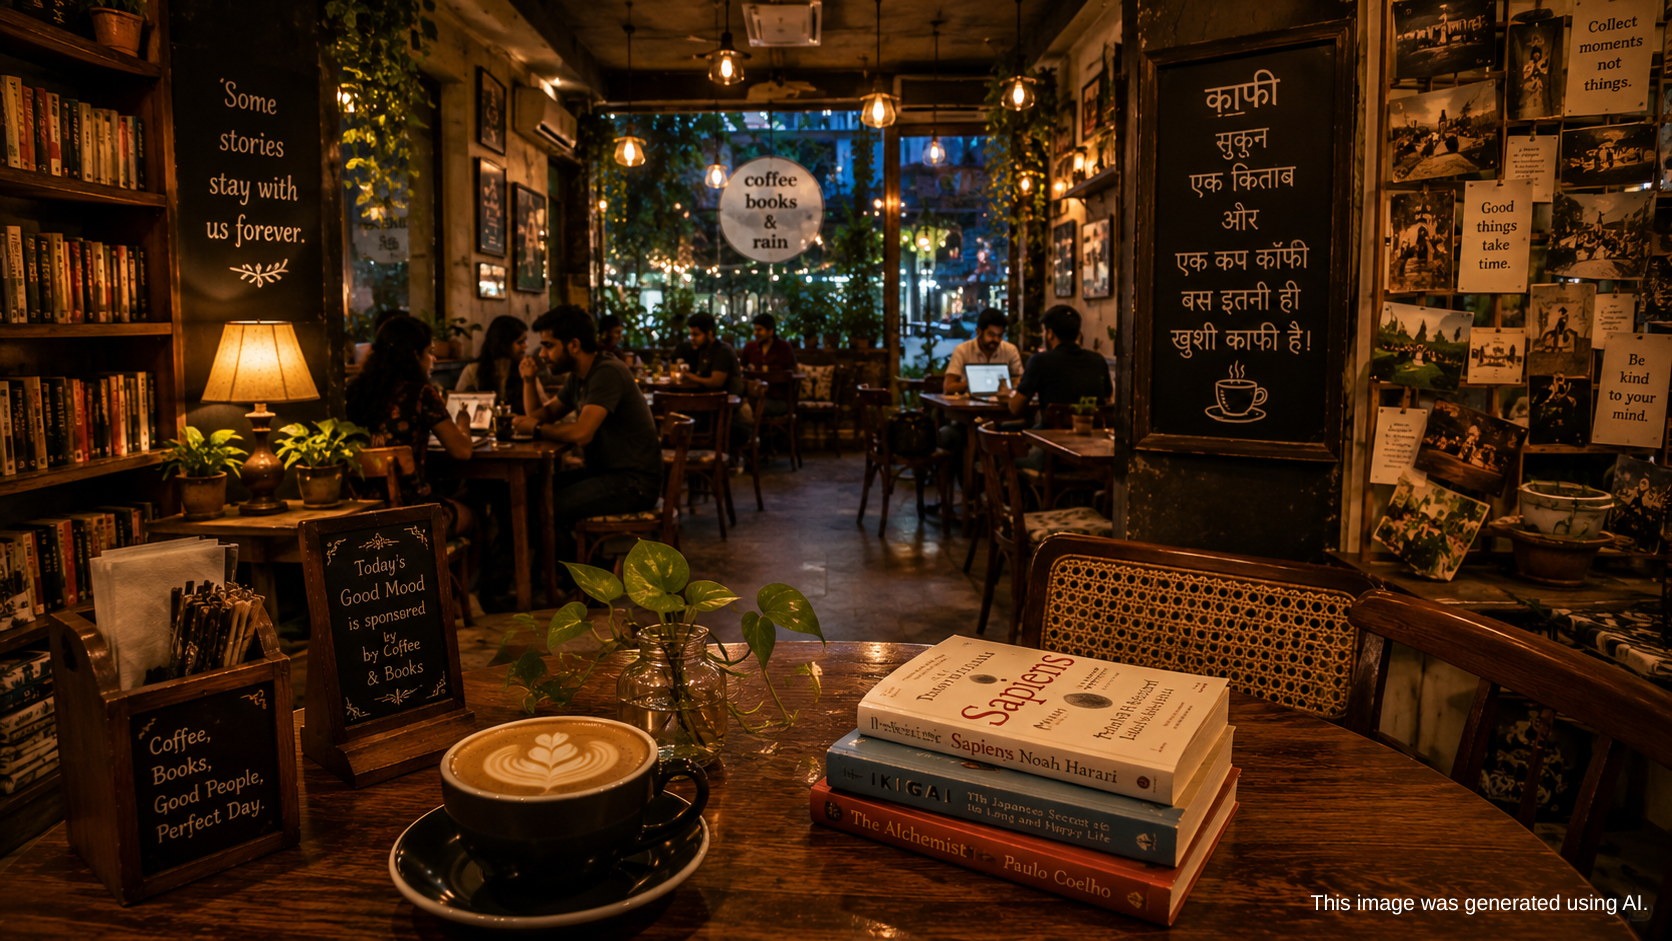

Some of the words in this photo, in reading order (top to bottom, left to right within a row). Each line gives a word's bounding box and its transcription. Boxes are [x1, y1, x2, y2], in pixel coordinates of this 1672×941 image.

[1588, 16, 1638, 33] Collect
[1579, 36, 1643, 54] moments
[1597, 57, 1622, 71] not
[1584, 76, 1632, 93] things.
[219, 130, 284, 158] stories
[1215, 127, 1270, 160] सुकून
[209, 172, 250, 206] stay
[257, 174, 298, 201] with
[744, 171, 798, 187] coffee
[1189, 172, 1224, 198] एक
[1231, 162, 1296, 192] किताब
[745, 193, 798, 209] books
[1481, 200, 1514, 214] Good
[764, 214, 776, 229] &
[1221, 202, 1260, 231] और
[1477, 219, 1517, 235] things
[206, 221, 229, 240] us
[235, 213, 306, 248] forever.
[753, 234, 788, 249] rain
[1174, 252, 1208, 277] एक
[1214, 250, 1249, 271] कप
[1256, 239, 1310, 269] कॉफी
[1482, 239, 1510, 251] take
[1478, 258, 1511, 270] time.
[1181, 290, 1214, 312] बस
[1220, 281, 1272, 315] इतनी
[1278, 280, 1302, 314] ही
[1170, 322, 1218, 359] खुशी
[1226, 322, 1280, 351] काफी
[1628, 353, 1645, 366] Be
[1620, 372, 1650, 385] kind
[1609, 390, 1622, 401] to
[1625, 393, 1656, 405] your
[1612, 410, 1648, 422] mind.
[354, 554, 406, 577] Today's
[340, 583, 380, 607] Good
[386, 574, 426, 598] Mood
[348, 616, 360, 631] is
[362, 646, 379, 664] by
[383, 638, 421, 657] Coffee
[367, 670, 380, 686] &
[384, 659, 424, 682] Books
[961, 653, 1076, 727] Sapiens
[149, 726, 211, 756] Coffee,
[152, 756, 213, 785] Books,
[1019, 748, 1060, 771] Noah
[1065, 759, 1118, 783] Harari
[154, 786, 200, 816] Good
[206, 768, 265, 801] People,
[871, 772, 952, 803] IKIGAI
[156, 808, 221, 844] Perfect
[228, 799, 266, 821] Day.
[851, 809, 880, 833] The
[884, 820, 967, 858] Alchemist
[1003, 854, 1047, 880] Paulo
[1054, 870, 1112, 899] Coelho
